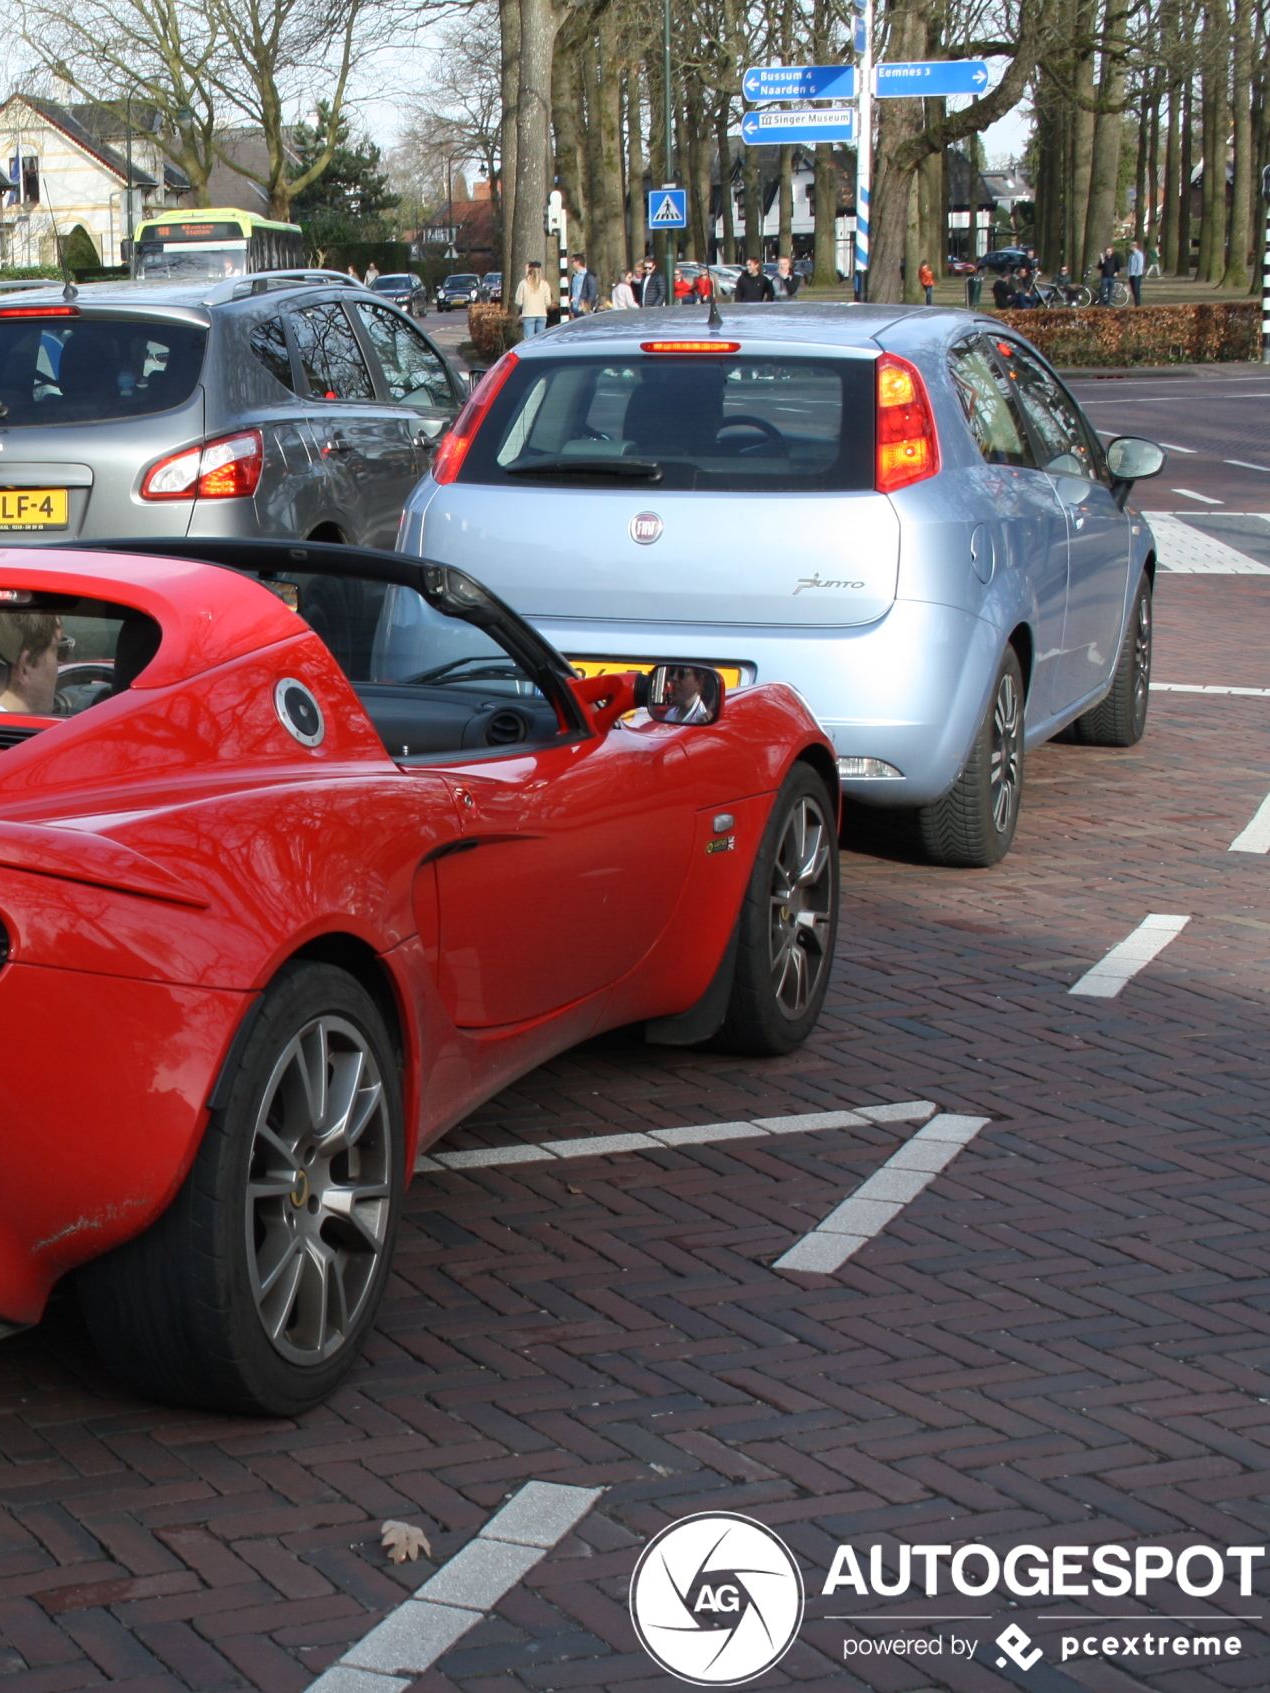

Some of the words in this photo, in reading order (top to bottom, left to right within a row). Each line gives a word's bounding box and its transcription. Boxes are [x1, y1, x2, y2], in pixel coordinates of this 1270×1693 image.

[760, 71, 802, 81] Bussum
[805, 71, 813, 80] 4
[878, 66, 922, 77] Eemnes
[924, 67, 931, 76] 3
[760, 85, 806, 95] Naarden
[809, 85, 816, 94] 6
[773, 115, 805, 126] Singer
[808, 113, 849, 123] Museum
[637, 520, 657, 536] FIAT
